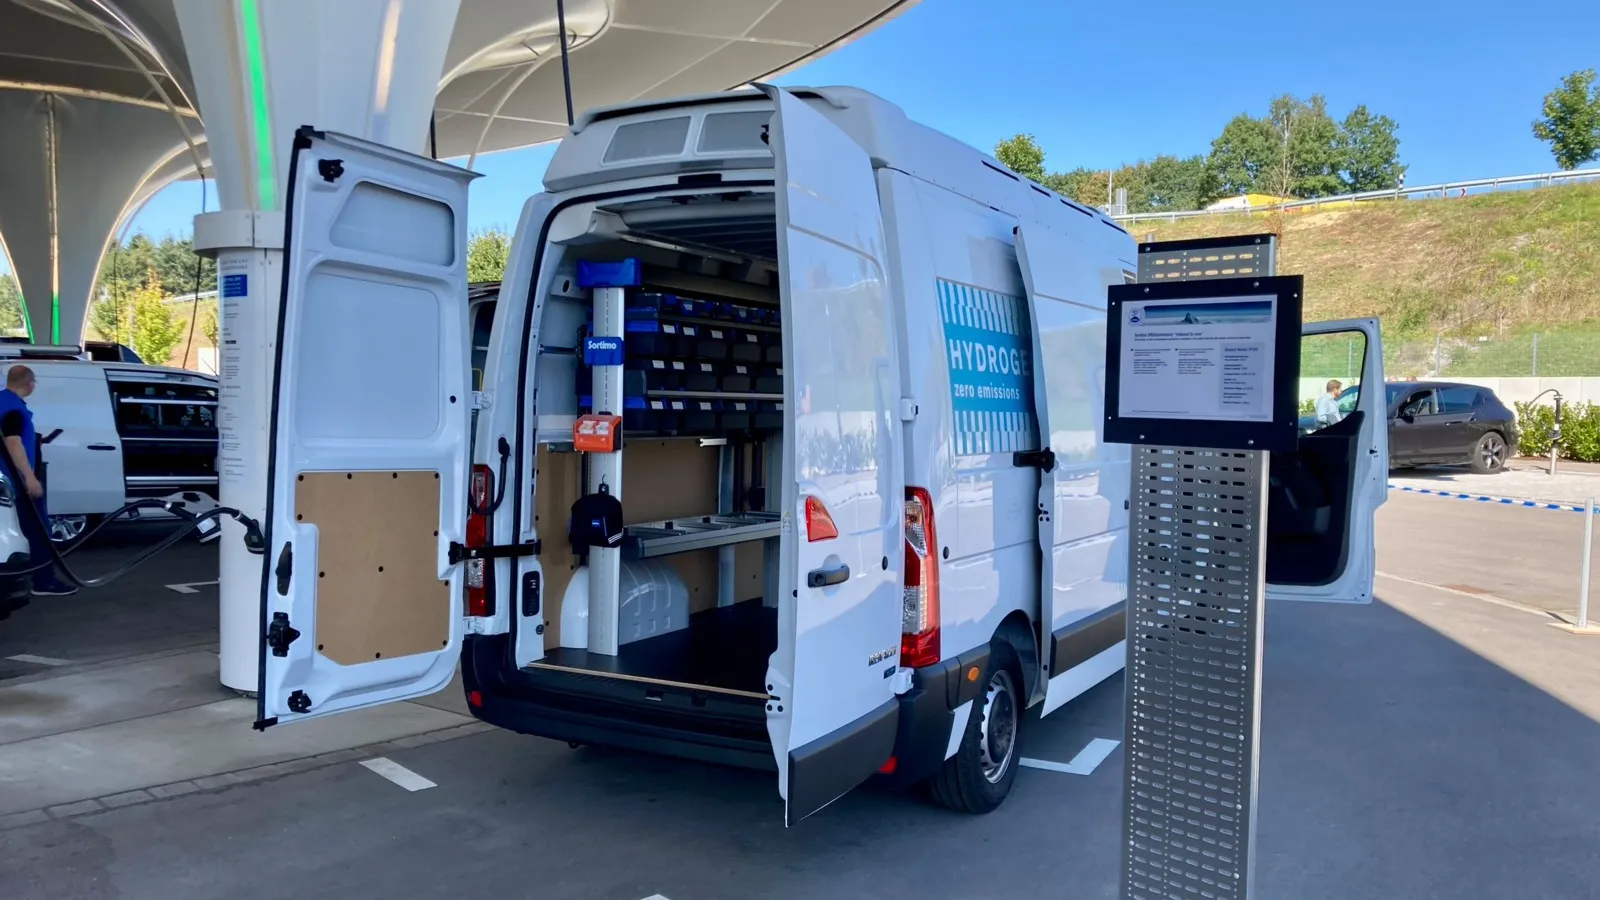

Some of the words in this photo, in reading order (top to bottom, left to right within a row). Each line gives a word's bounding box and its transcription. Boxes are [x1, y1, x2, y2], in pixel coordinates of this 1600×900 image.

[588, 340, 617, 350] Sortimo
[949, 338, 1032, 377] HYDROGE
[954, 383, 975, 398] zero
[977, 382, 1020, 400] emissions
